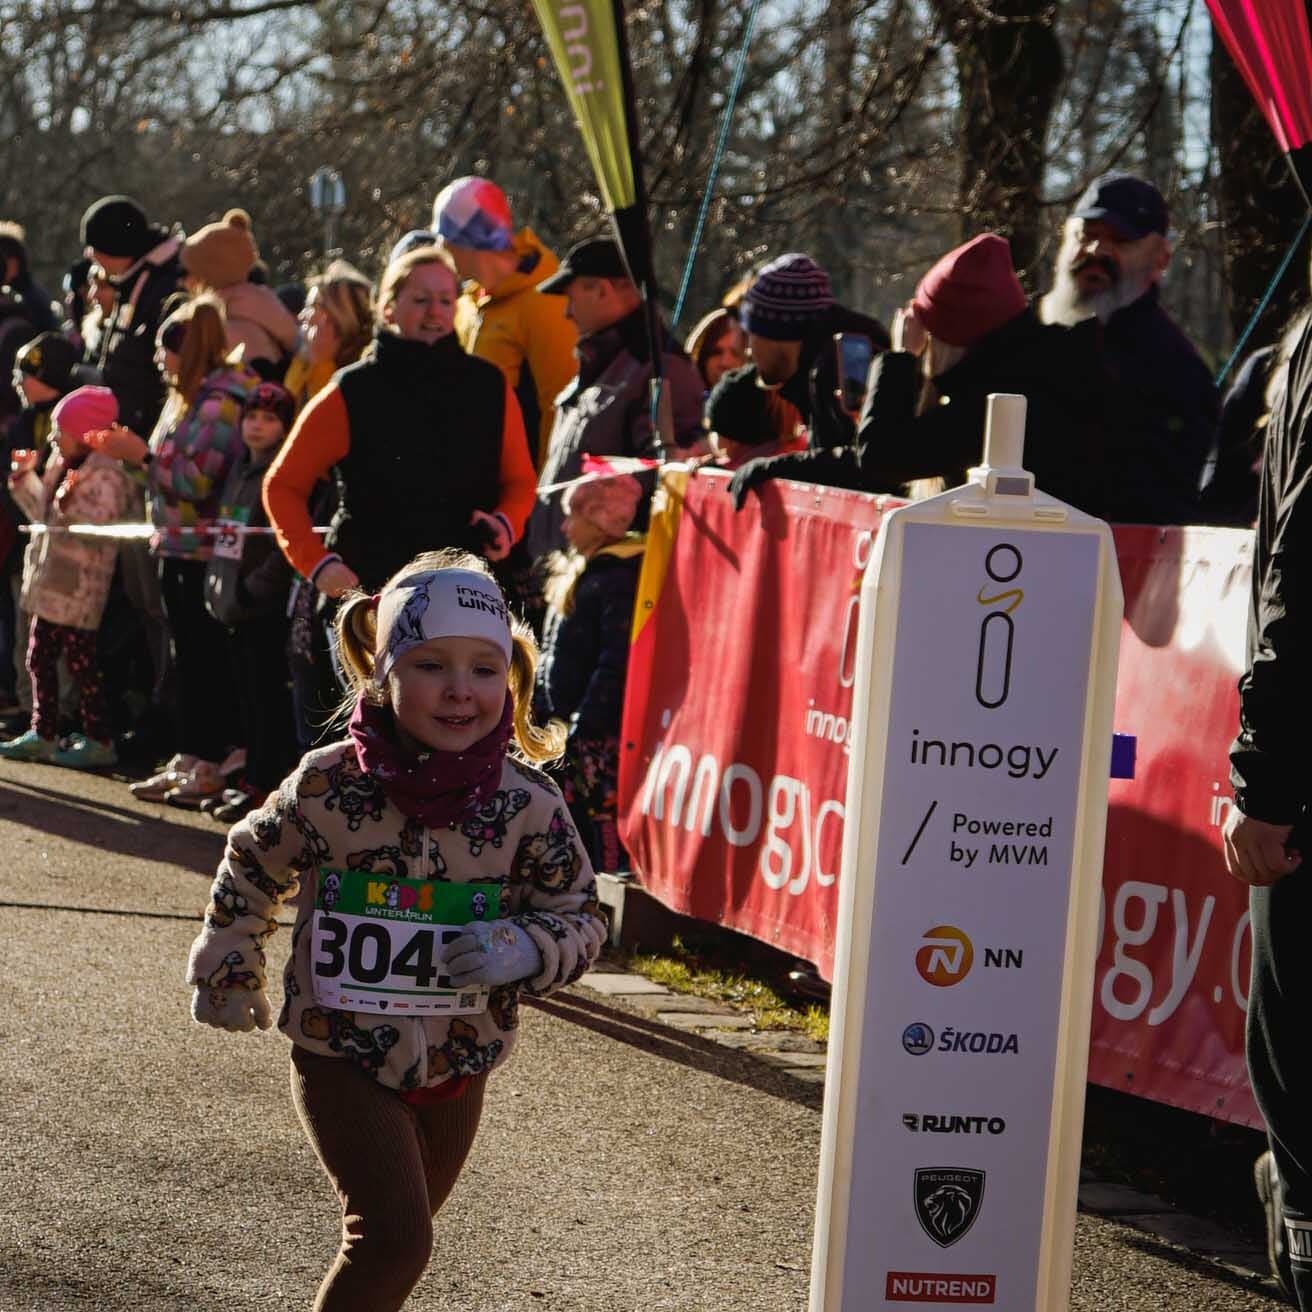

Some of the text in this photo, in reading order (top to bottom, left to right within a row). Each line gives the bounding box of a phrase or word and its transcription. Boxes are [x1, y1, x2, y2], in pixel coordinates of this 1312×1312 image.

[458, 596, 506, 621] WINT
[910, 729, 1059, 779] innogy
[952, 813, 1053, 838] Powered
[949, 842, 1049, 868] by MVM
[315, 916, 464, 988] 304
[984, 948, 1023, 969] NN
[937, 1026, 1019, 1055] ŠKODA
[921, 1114, 1006, 1135] RUNTO
[921, 1174, 978, 1183] PEUGEOT
[892, 1278, 991, 1297] NUTREND
